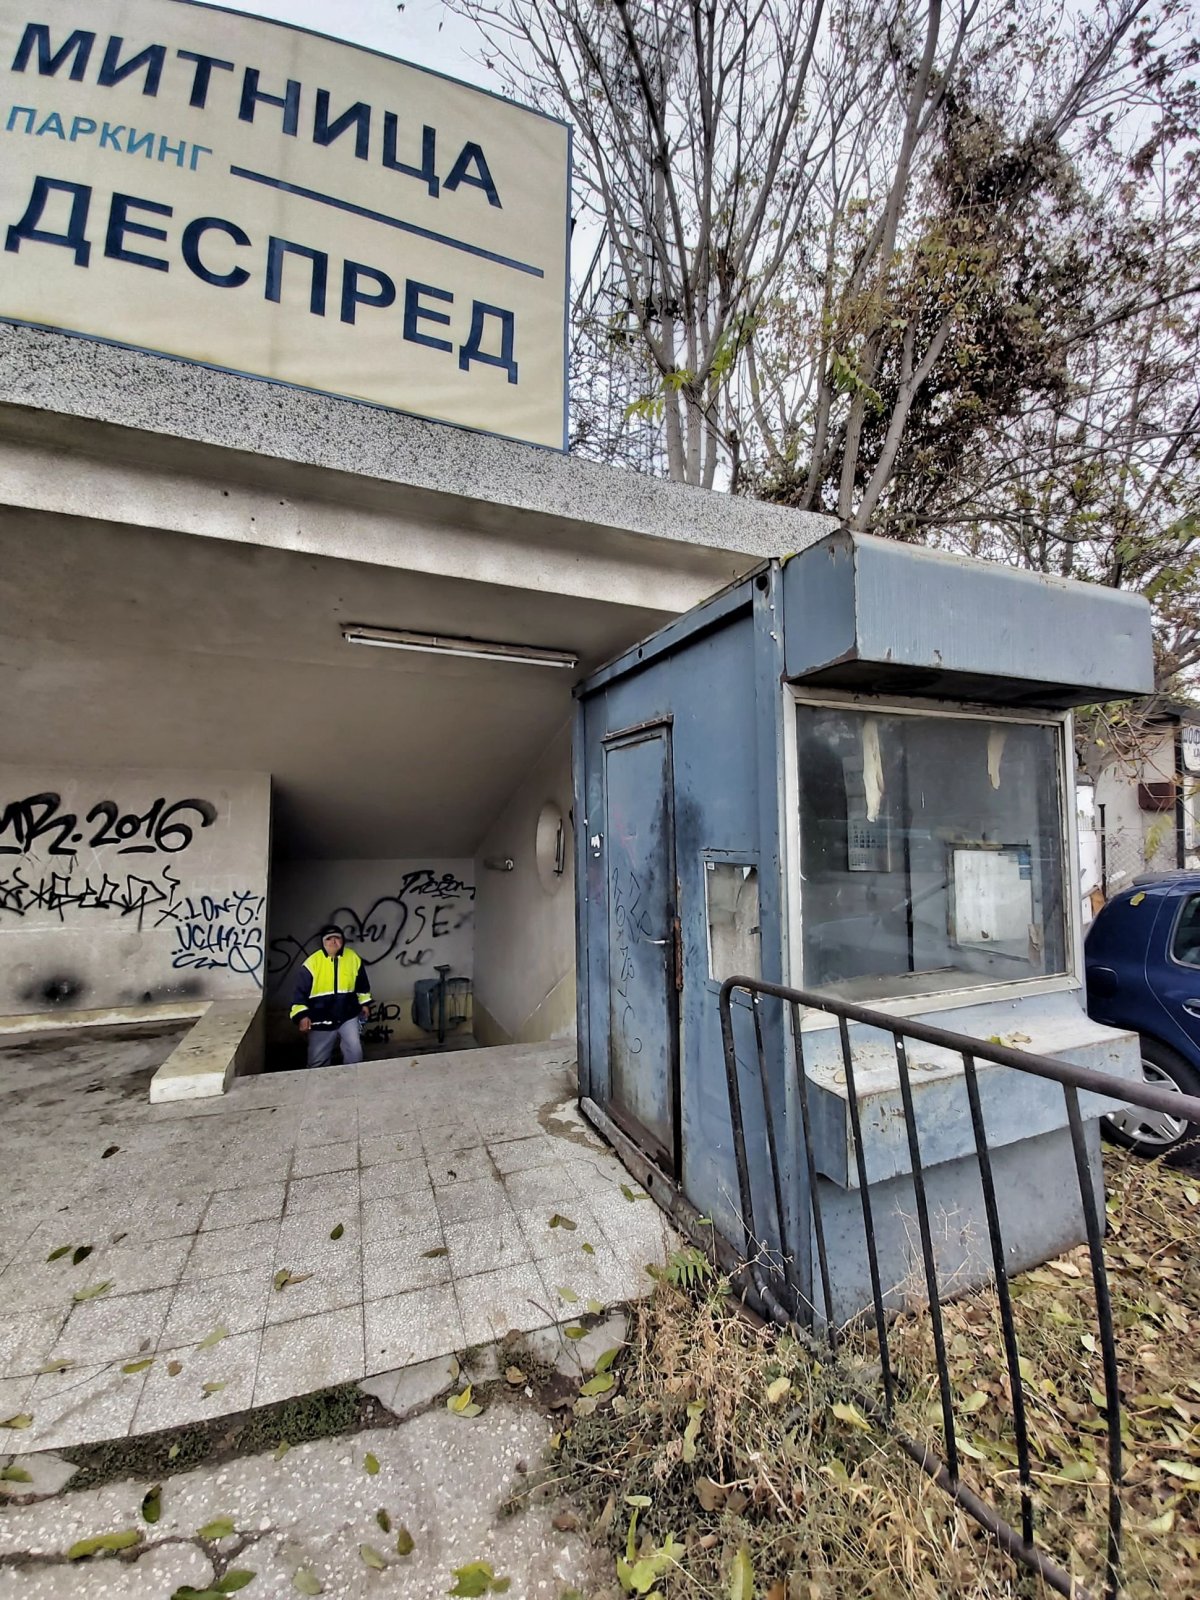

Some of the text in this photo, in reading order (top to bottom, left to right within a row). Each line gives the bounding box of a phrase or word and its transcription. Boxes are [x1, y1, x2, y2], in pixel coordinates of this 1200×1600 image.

[5, 105, 213, 172] ПАРКИНГ
[10, 22, 503, 210] МИТНИЦА
[4, 175, 519, 385] ДЕСПРЕД
